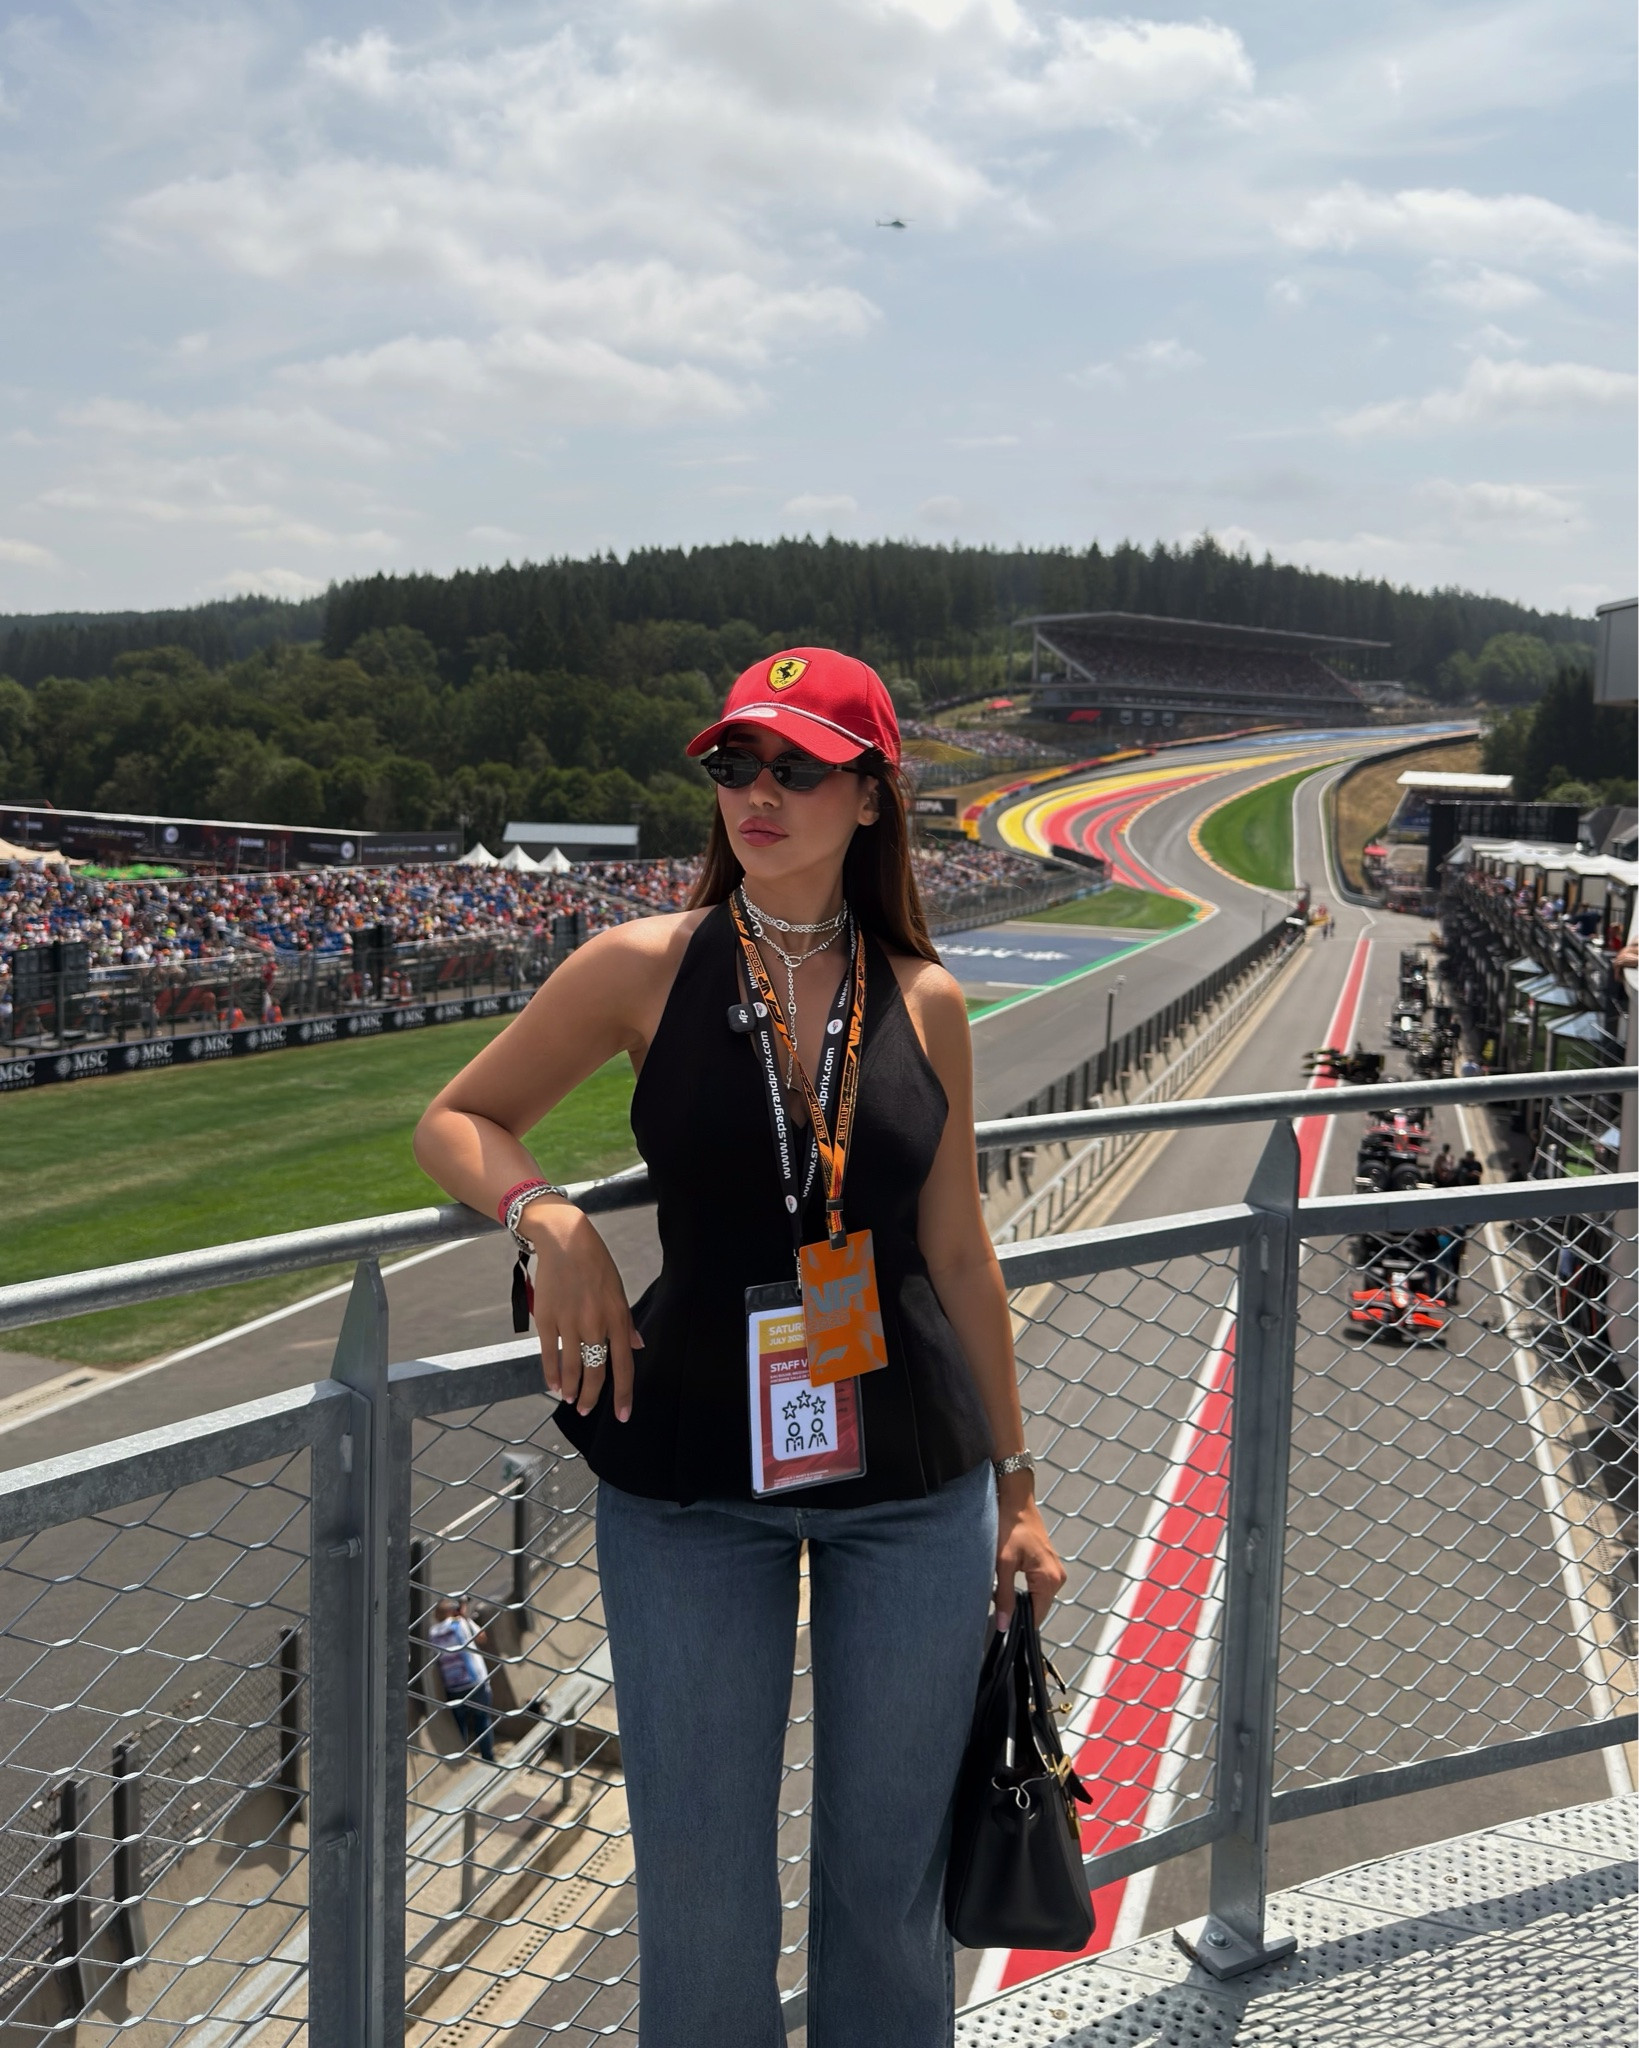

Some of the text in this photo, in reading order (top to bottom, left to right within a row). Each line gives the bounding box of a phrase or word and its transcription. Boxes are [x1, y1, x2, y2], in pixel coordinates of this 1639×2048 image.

[757, 976, 770, 996] VIP
[260, 1026, 287, 1042] MSC
[313, 1020, 337, 1035] MSC
[847, 1015, 862, 1047] VIP
[141, 1041, 174, 1060] MSC
[205, 1034, 233, 1051] MSC
[73, 1050, 108, 1071] MSC
[760, 1030, 792, 1179] www.spagrandprix.com
[810, 1101, 826, 1140] BELGIUM
[837, 1101, 850, 1141] BELGIUM
[503, 1187, 524, 1207] Rouge
[809, 1275, 863, 1313] VIP
[770, 1359, 800, 1373] STAFF
